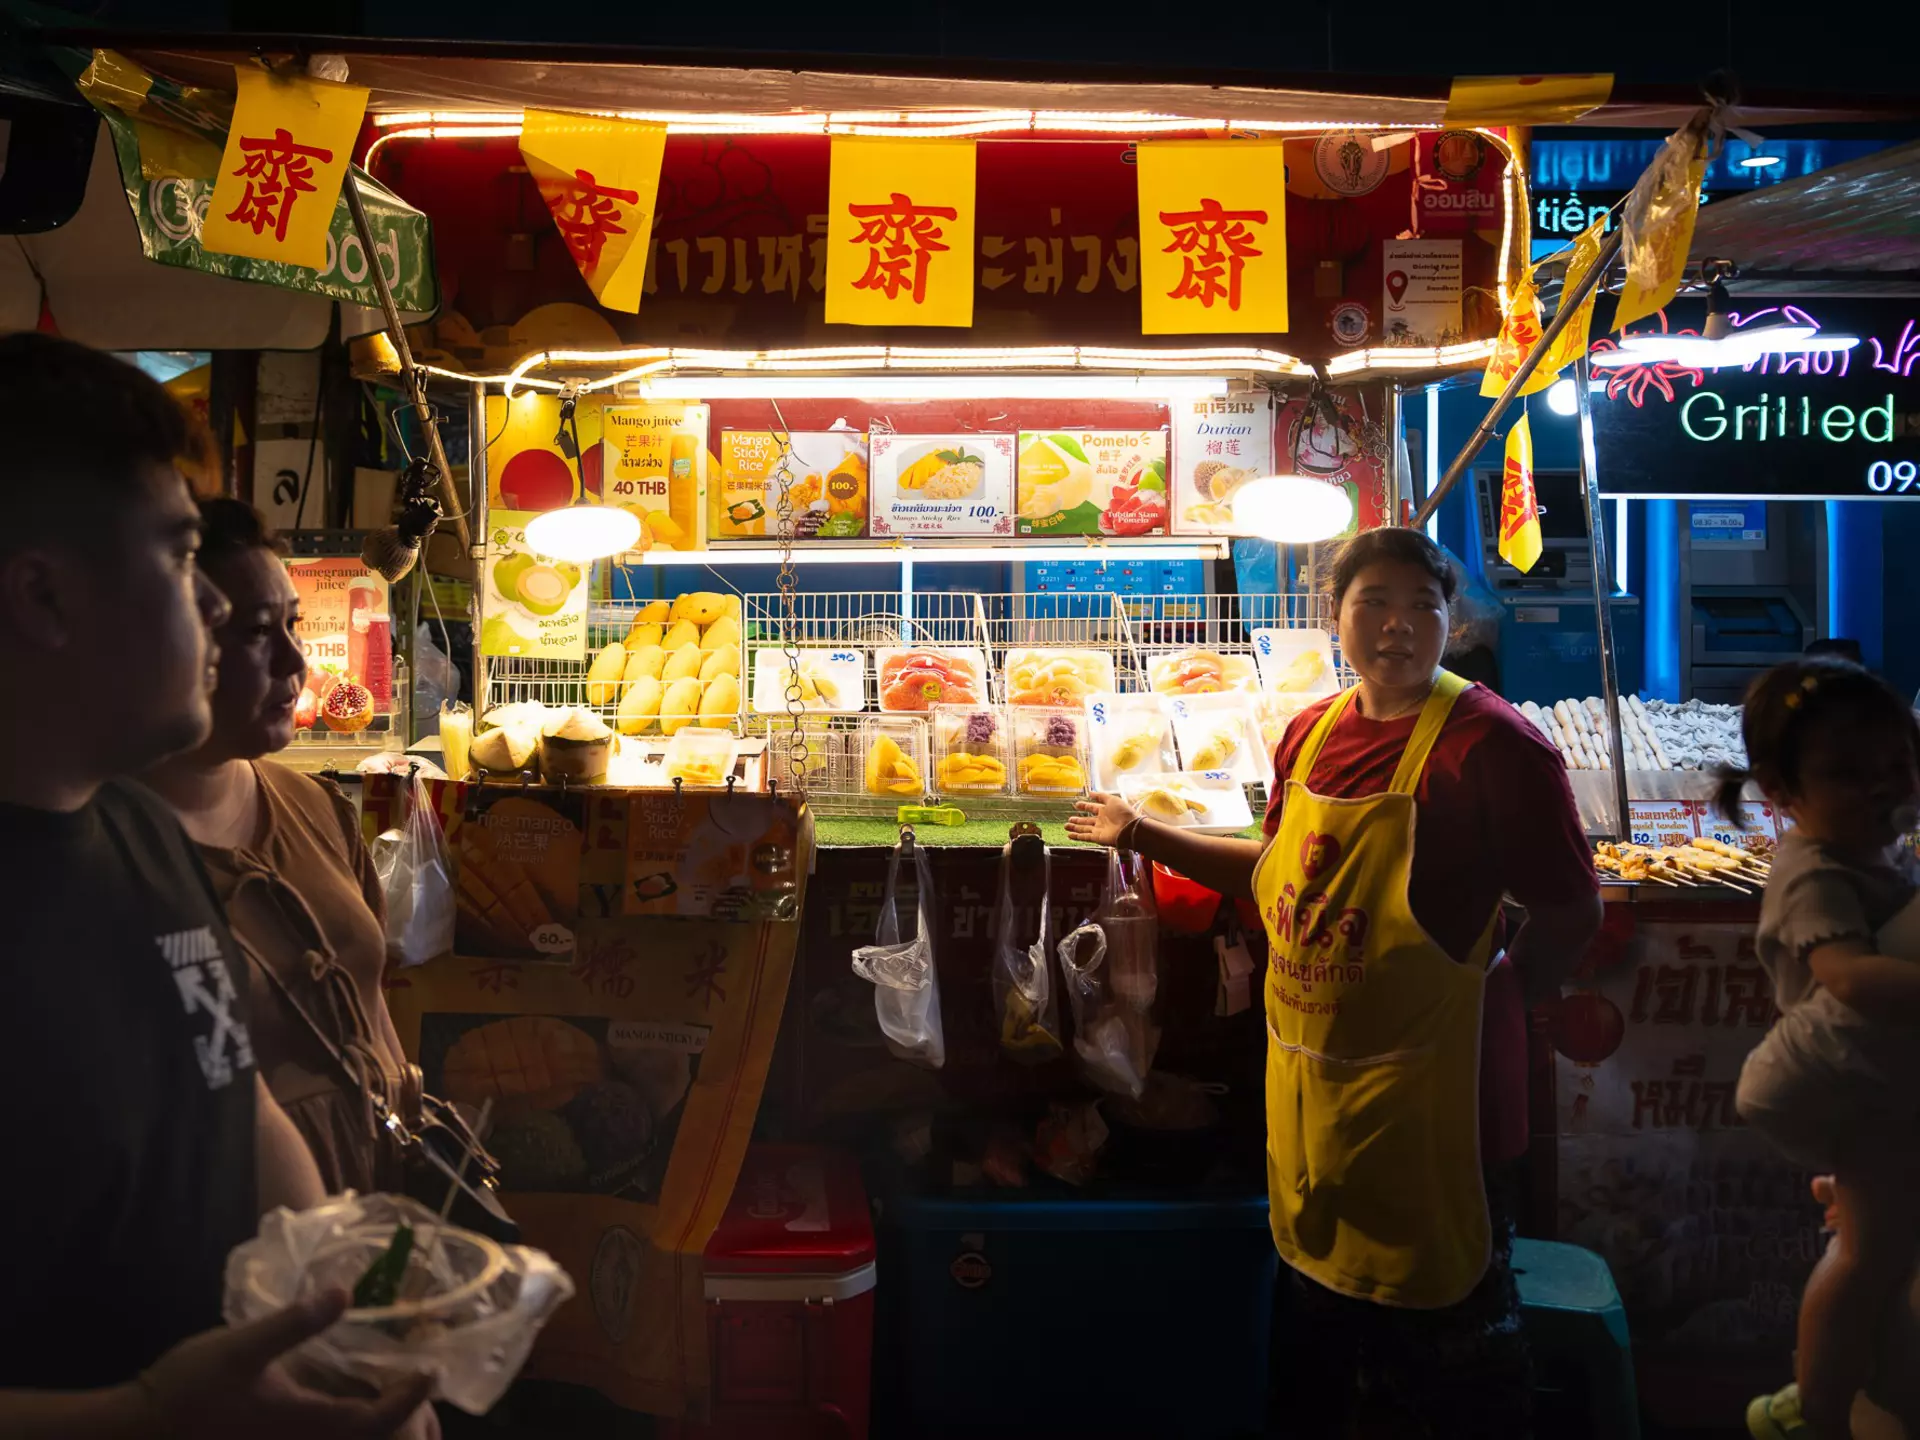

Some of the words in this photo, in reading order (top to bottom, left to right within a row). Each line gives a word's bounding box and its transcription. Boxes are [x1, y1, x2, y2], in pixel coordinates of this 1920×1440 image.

[226, 128, 333, 242] 齋
[1423, 189, 1495, 209] ออมสิน
[847, 193, 957, 304] 齋
[1160, 198, 1268, 311] 齋
[1193, 396, 1255, 419] ทุเรียน
[611, 415, 650, 428] Mango
[652, 415, 682, 428] juice
[1681, 391, 1894, 442] Grilled
[1197, 422, 1252, 435] Durian
[625, 434, 665, 448] 芒果汁
[731, 434, 770, 449] Mango
[1082, 434, 1139, 447] Pomelo
[1206, 439, 1242, 456] 榴莲
[734, 447, 769, 459] Sticky
[1099, 450, 1122, 461] 柚子
[739, 460, 764, 470] Rice
[1868, 461, 1920, 493] 09
[613, 482, 634, 496] 40
[637, 482, 667, 496] THB
[893, 515, 918, 523] Mango
[968, 506, 1005, 518] 100.-
[290, 567, 371, 581] Pomegranate
[315, 580, 346, 592] juice
[317, 643, 346, 657] THB
[641, 796, 687, 813] Mango
[477, 811, 511, 832] ripe
[515, 816, 574, 838] mango
[643, 811, 685, 828] Sticky
[648, 827, 677, 839] Rice
